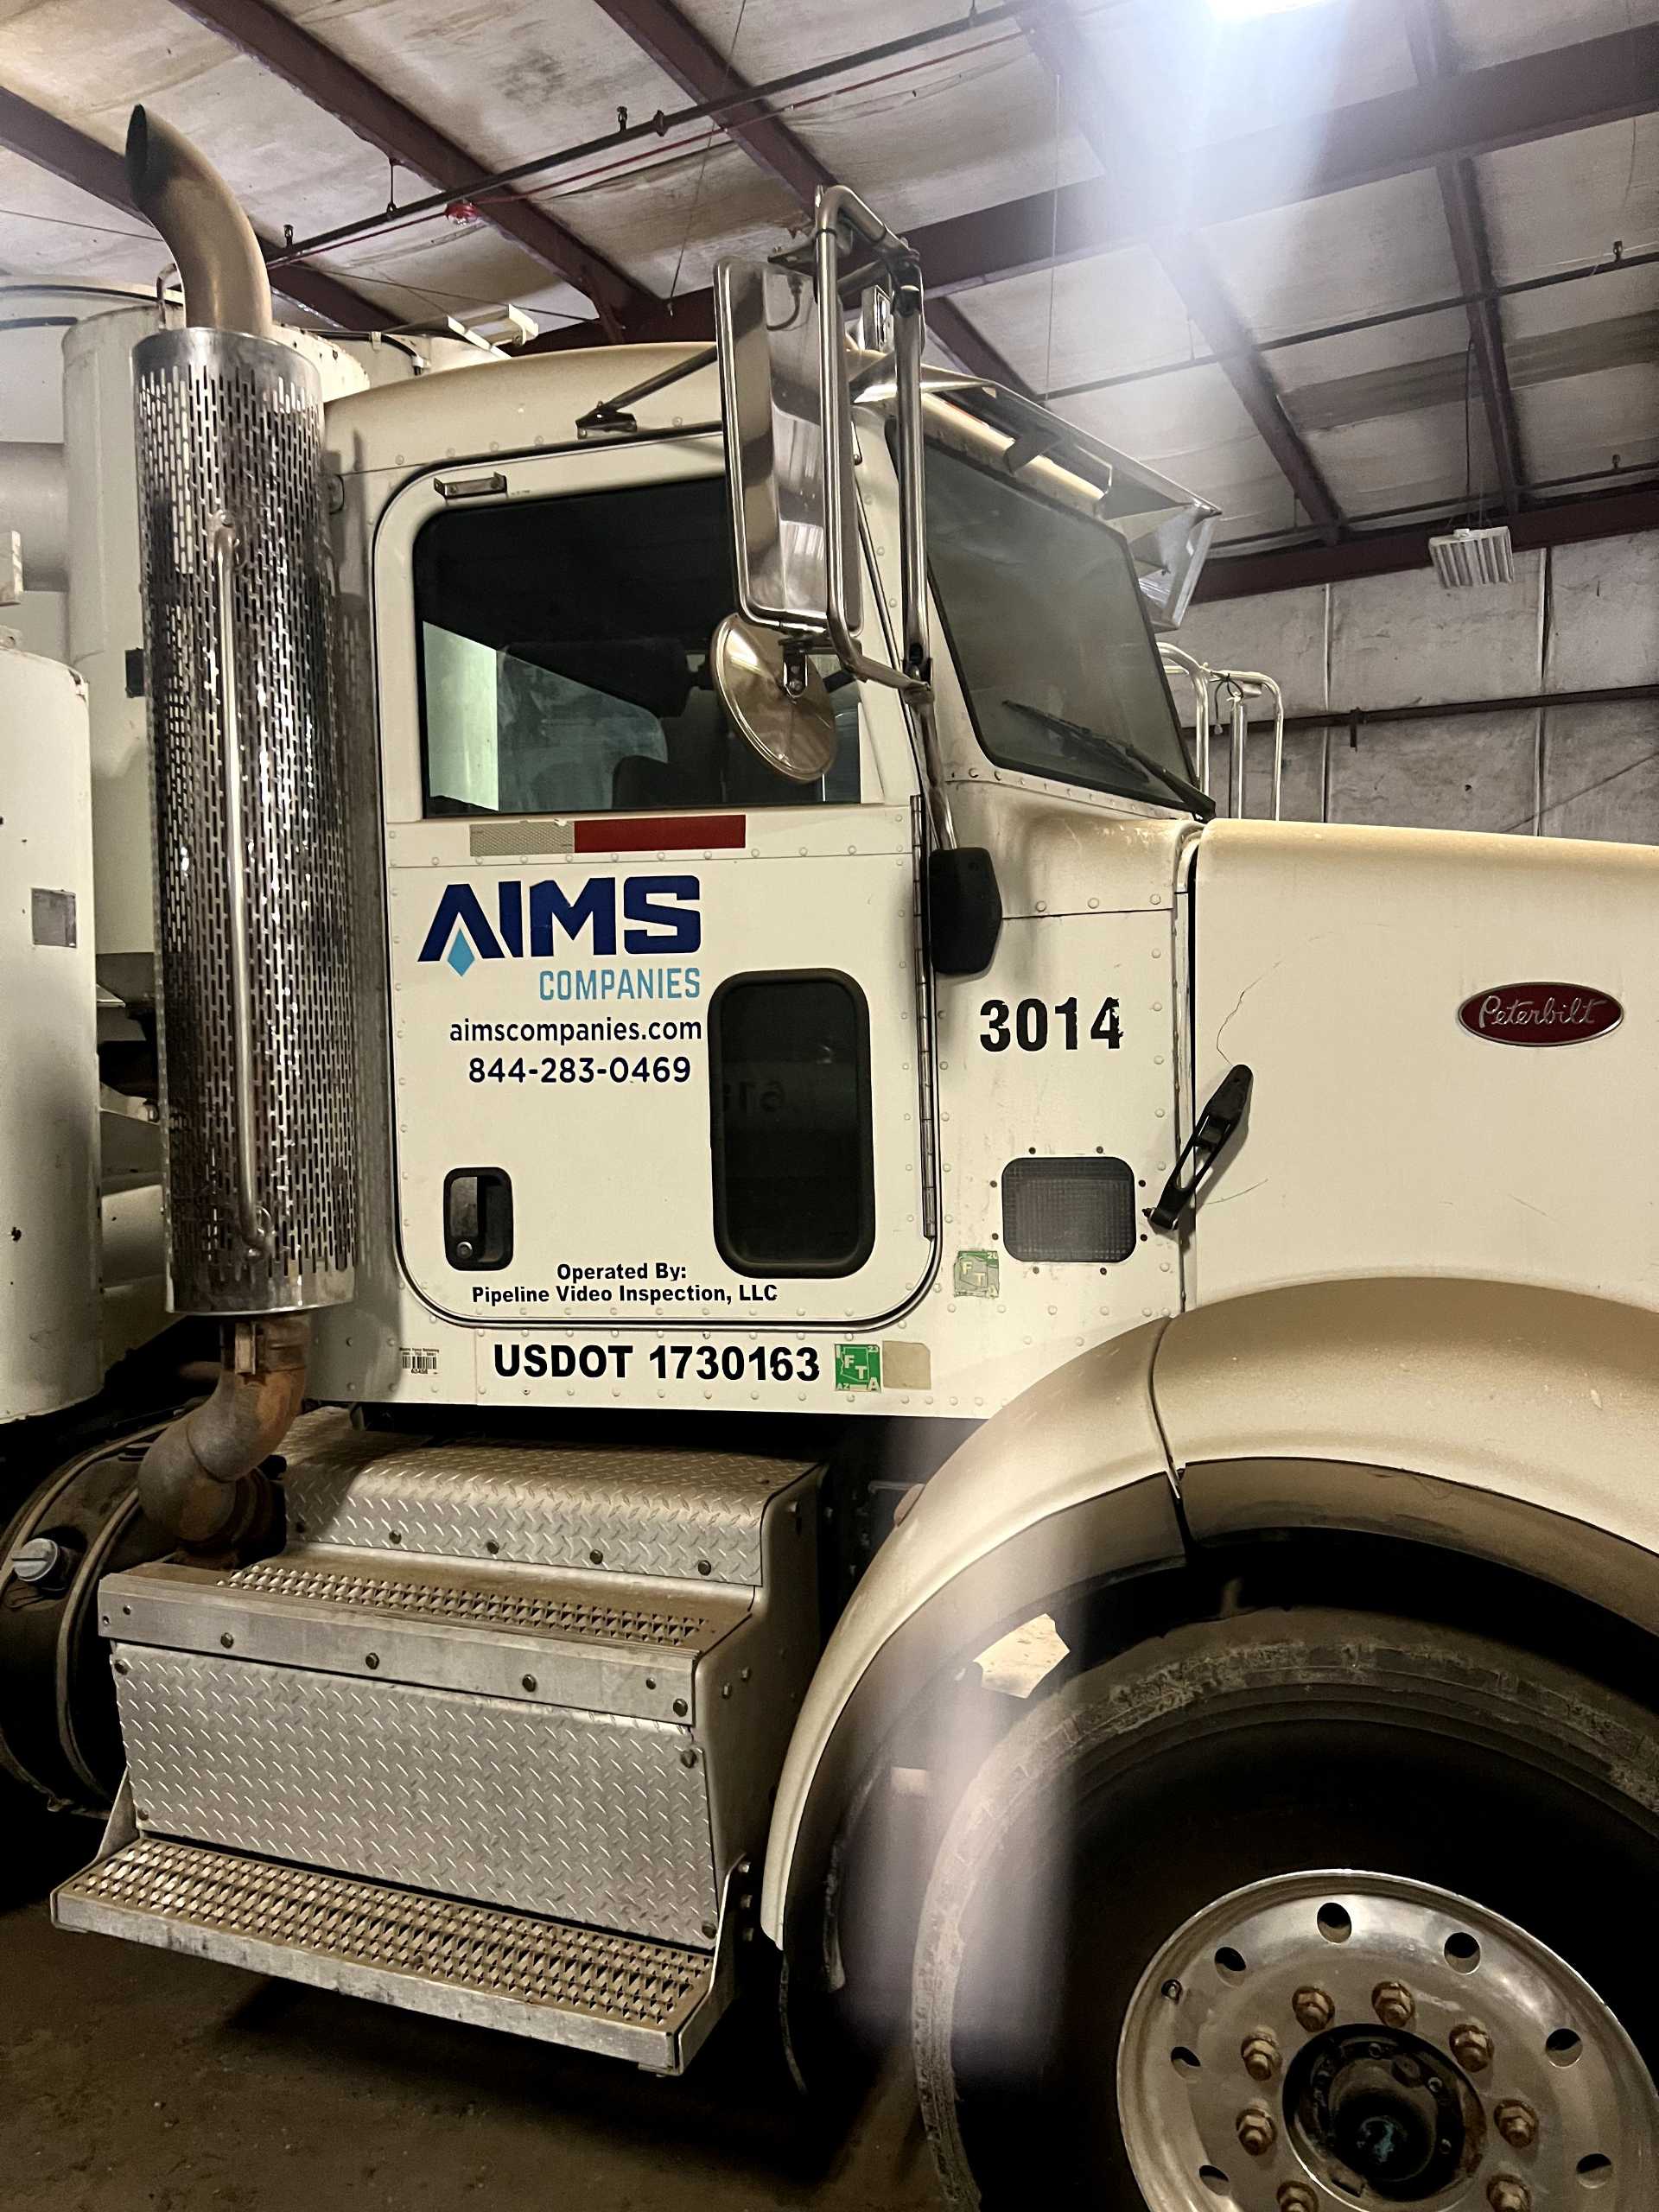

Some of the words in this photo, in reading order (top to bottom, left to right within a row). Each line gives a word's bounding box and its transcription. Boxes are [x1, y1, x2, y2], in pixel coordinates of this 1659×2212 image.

[417, 875, 701, 963] AIMS
[539, 967, 701, 1001] COMPANIES
[981, 997, 1123, 1052] 3014
[1478, 995, 1607, 1028] Peterbilt
[449, 1016, 702, 1046] aimscompanies.com
[468, 1056, 690, 1084] 844-283-0469
[557, 1262, 648, 1283] Operated
[655, 1262, 686, 1281] By:
[473, 1286, 550, 1307] Pipeline
[556, 1285, 613, 1302] Video
[620, 1284, 732, 1306] Inspection,
[739, 1284, 778, 1301] LLC
[494, 1344, 633, 1378] USDOT
[649, 1344, 820, 1382] 1730163
